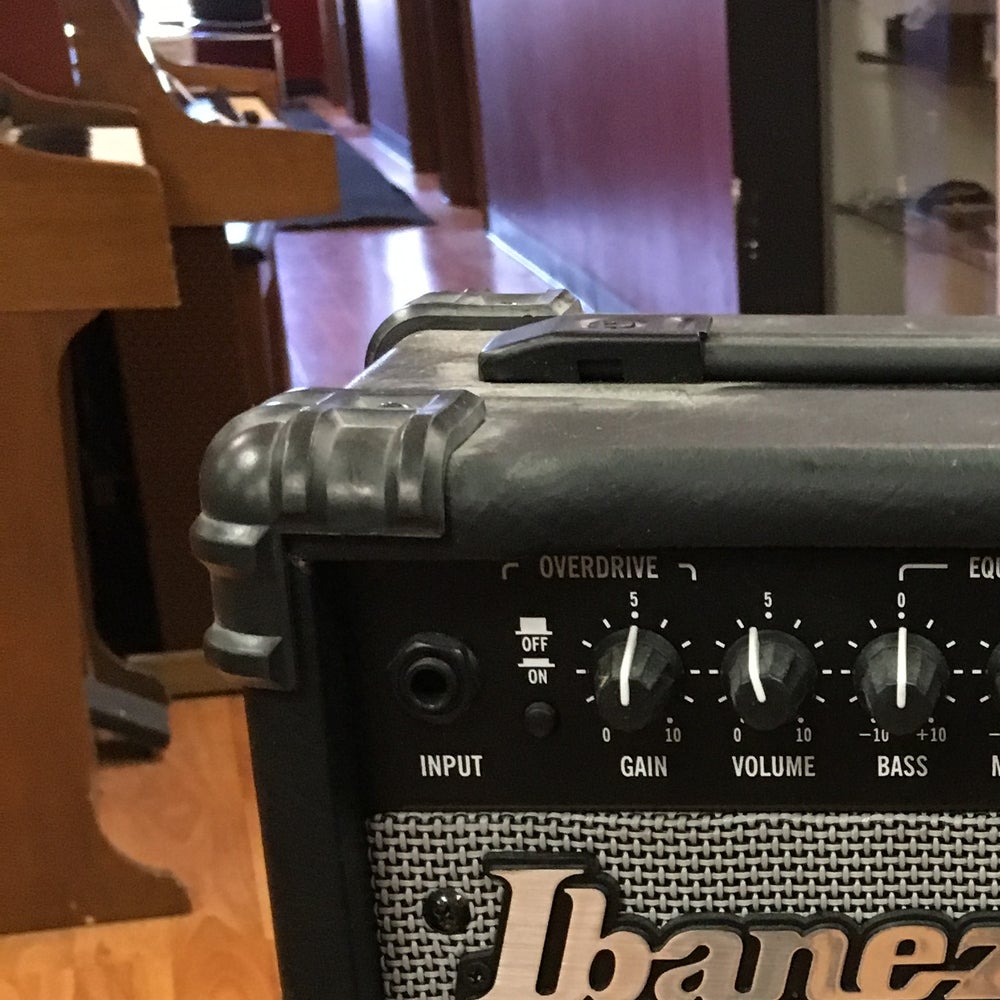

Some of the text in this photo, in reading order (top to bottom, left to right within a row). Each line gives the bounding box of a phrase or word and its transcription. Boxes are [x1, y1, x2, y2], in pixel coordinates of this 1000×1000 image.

[539, 555, 659, 579] OVERDRIVE
[629, 591, 639, 608] 5
[764, 591, 773, 608] 5
[897, 591, 906, 608] 0
[521, 636, 549, 652] OFF
[527, 668, 548, 685] ON
[602, 727, 611, 743] 0
[665, 727, 682, 743] 10
[733, 727, 742, 743] 0
[795, 727, 812, 743] 10
[916, 726, 947, 743] +10
[419, 754, 483, 777] INPUT
[620, 755, 668, 778] GAIN
[731, 755, 816, 778] VOLUME
[877, 755, 928, 777] BASS
